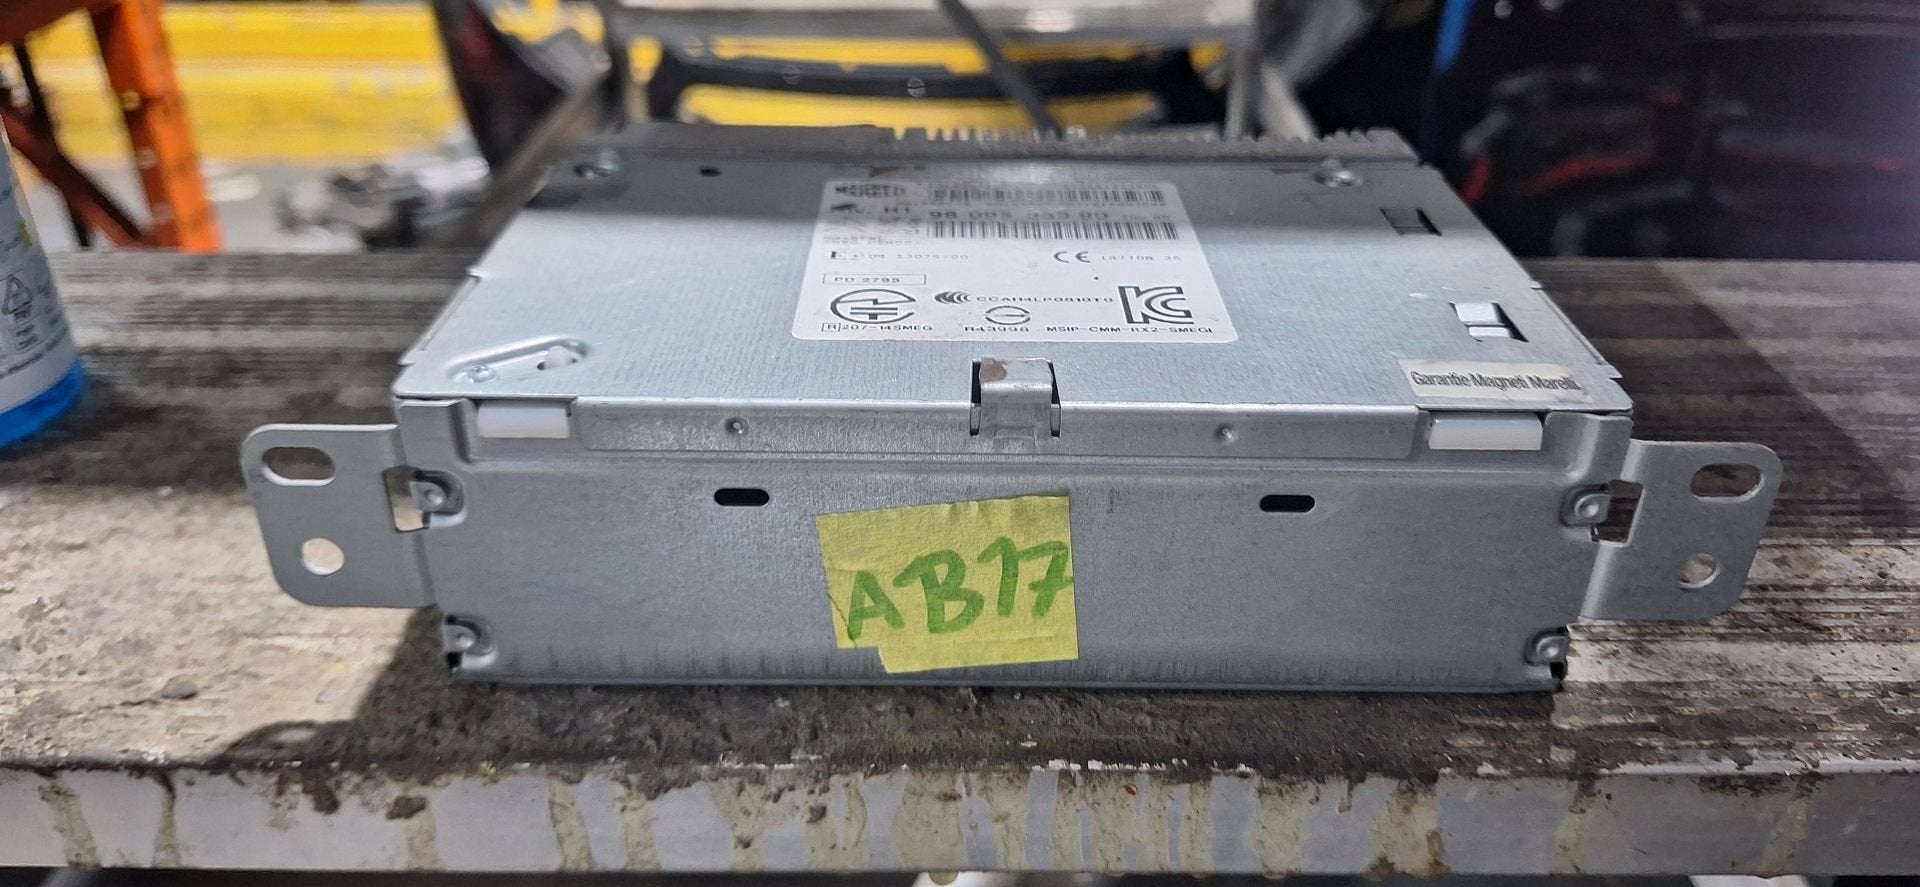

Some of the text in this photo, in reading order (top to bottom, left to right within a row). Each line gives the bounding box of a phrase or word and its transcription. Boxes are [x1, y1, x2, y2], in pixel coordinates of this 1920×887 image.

[1410, 371, 1582, 391] Garantie Magneti Marelli
[848, 536, 1074, 641] AB17
